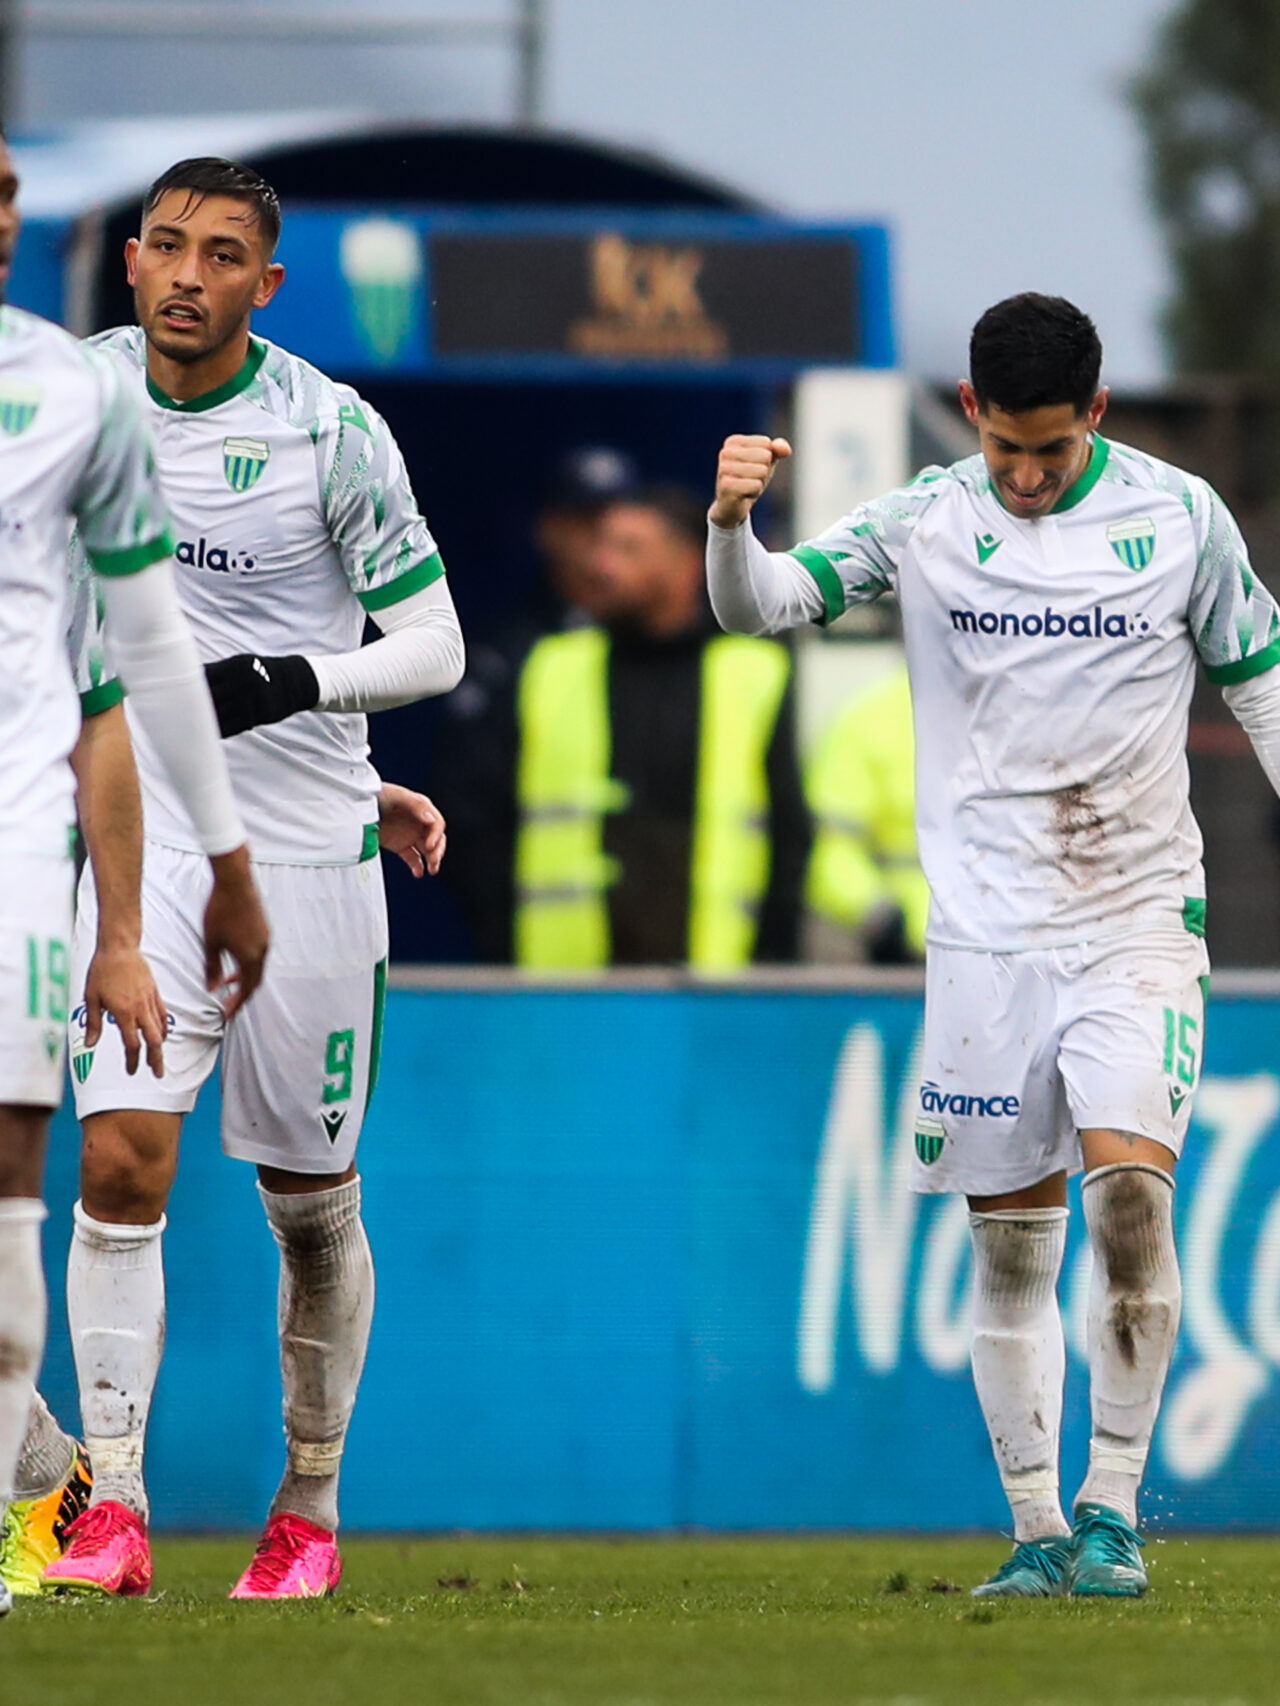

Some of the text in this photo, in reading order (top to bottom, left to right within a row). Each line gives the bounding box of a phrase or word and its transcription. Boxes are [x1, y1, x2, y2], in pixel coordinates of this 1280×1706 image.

[950, 606, 1128, 638] monobala
[321, 1027, 356, 1105] 9
[1162, 1005, 1198, 1088] 15
[921, 1084, 1020, 1118] avance
